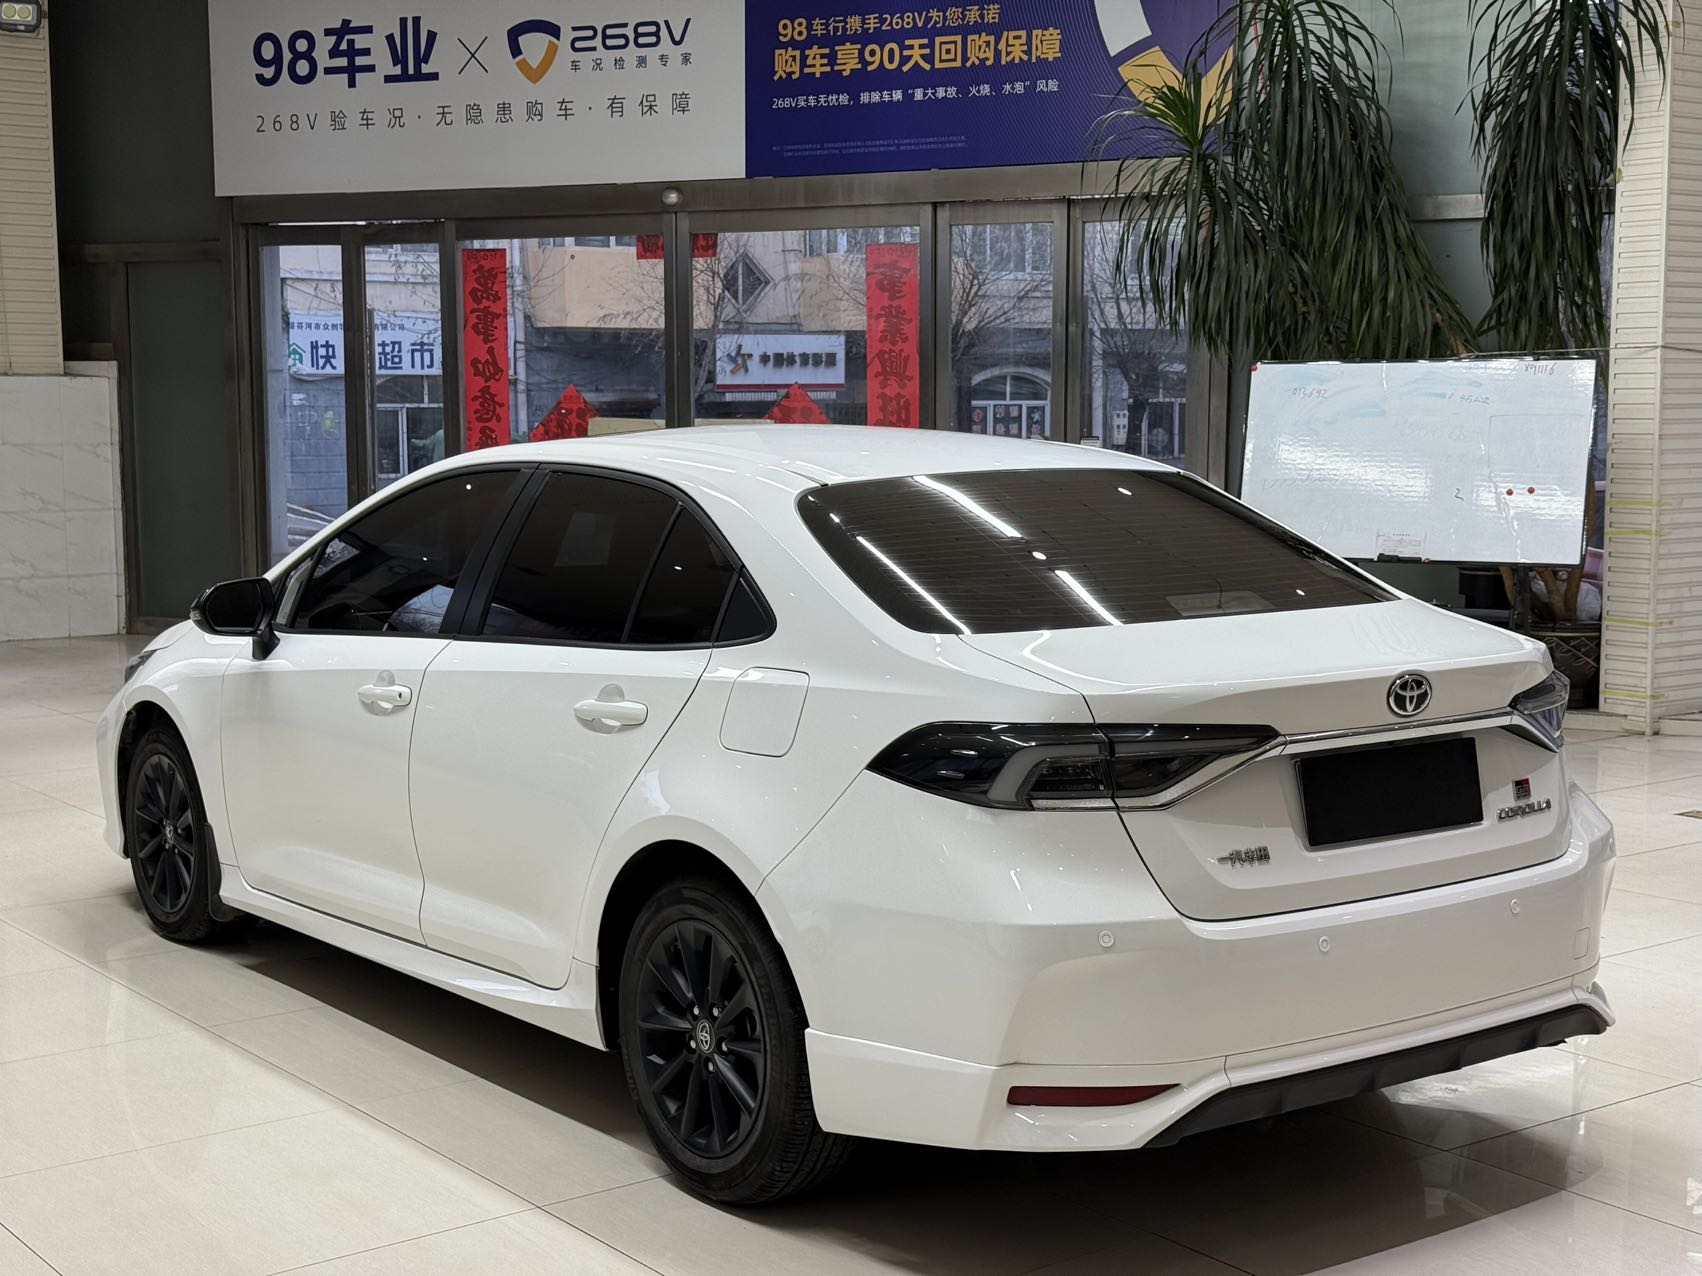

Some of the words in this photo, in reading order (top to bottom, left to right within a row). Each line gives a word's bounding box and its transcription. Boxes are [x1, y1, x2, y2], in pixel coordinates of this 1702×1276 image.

[253, 16, 440, 89] 98车业
[570, 18, 692, 53] 268V
[570, 52, 693, 73] 车况检测专家
[773, 27, 1062, 81] 购车享90天回购保障
[1496, 798, 1551, 822] COROLLA
